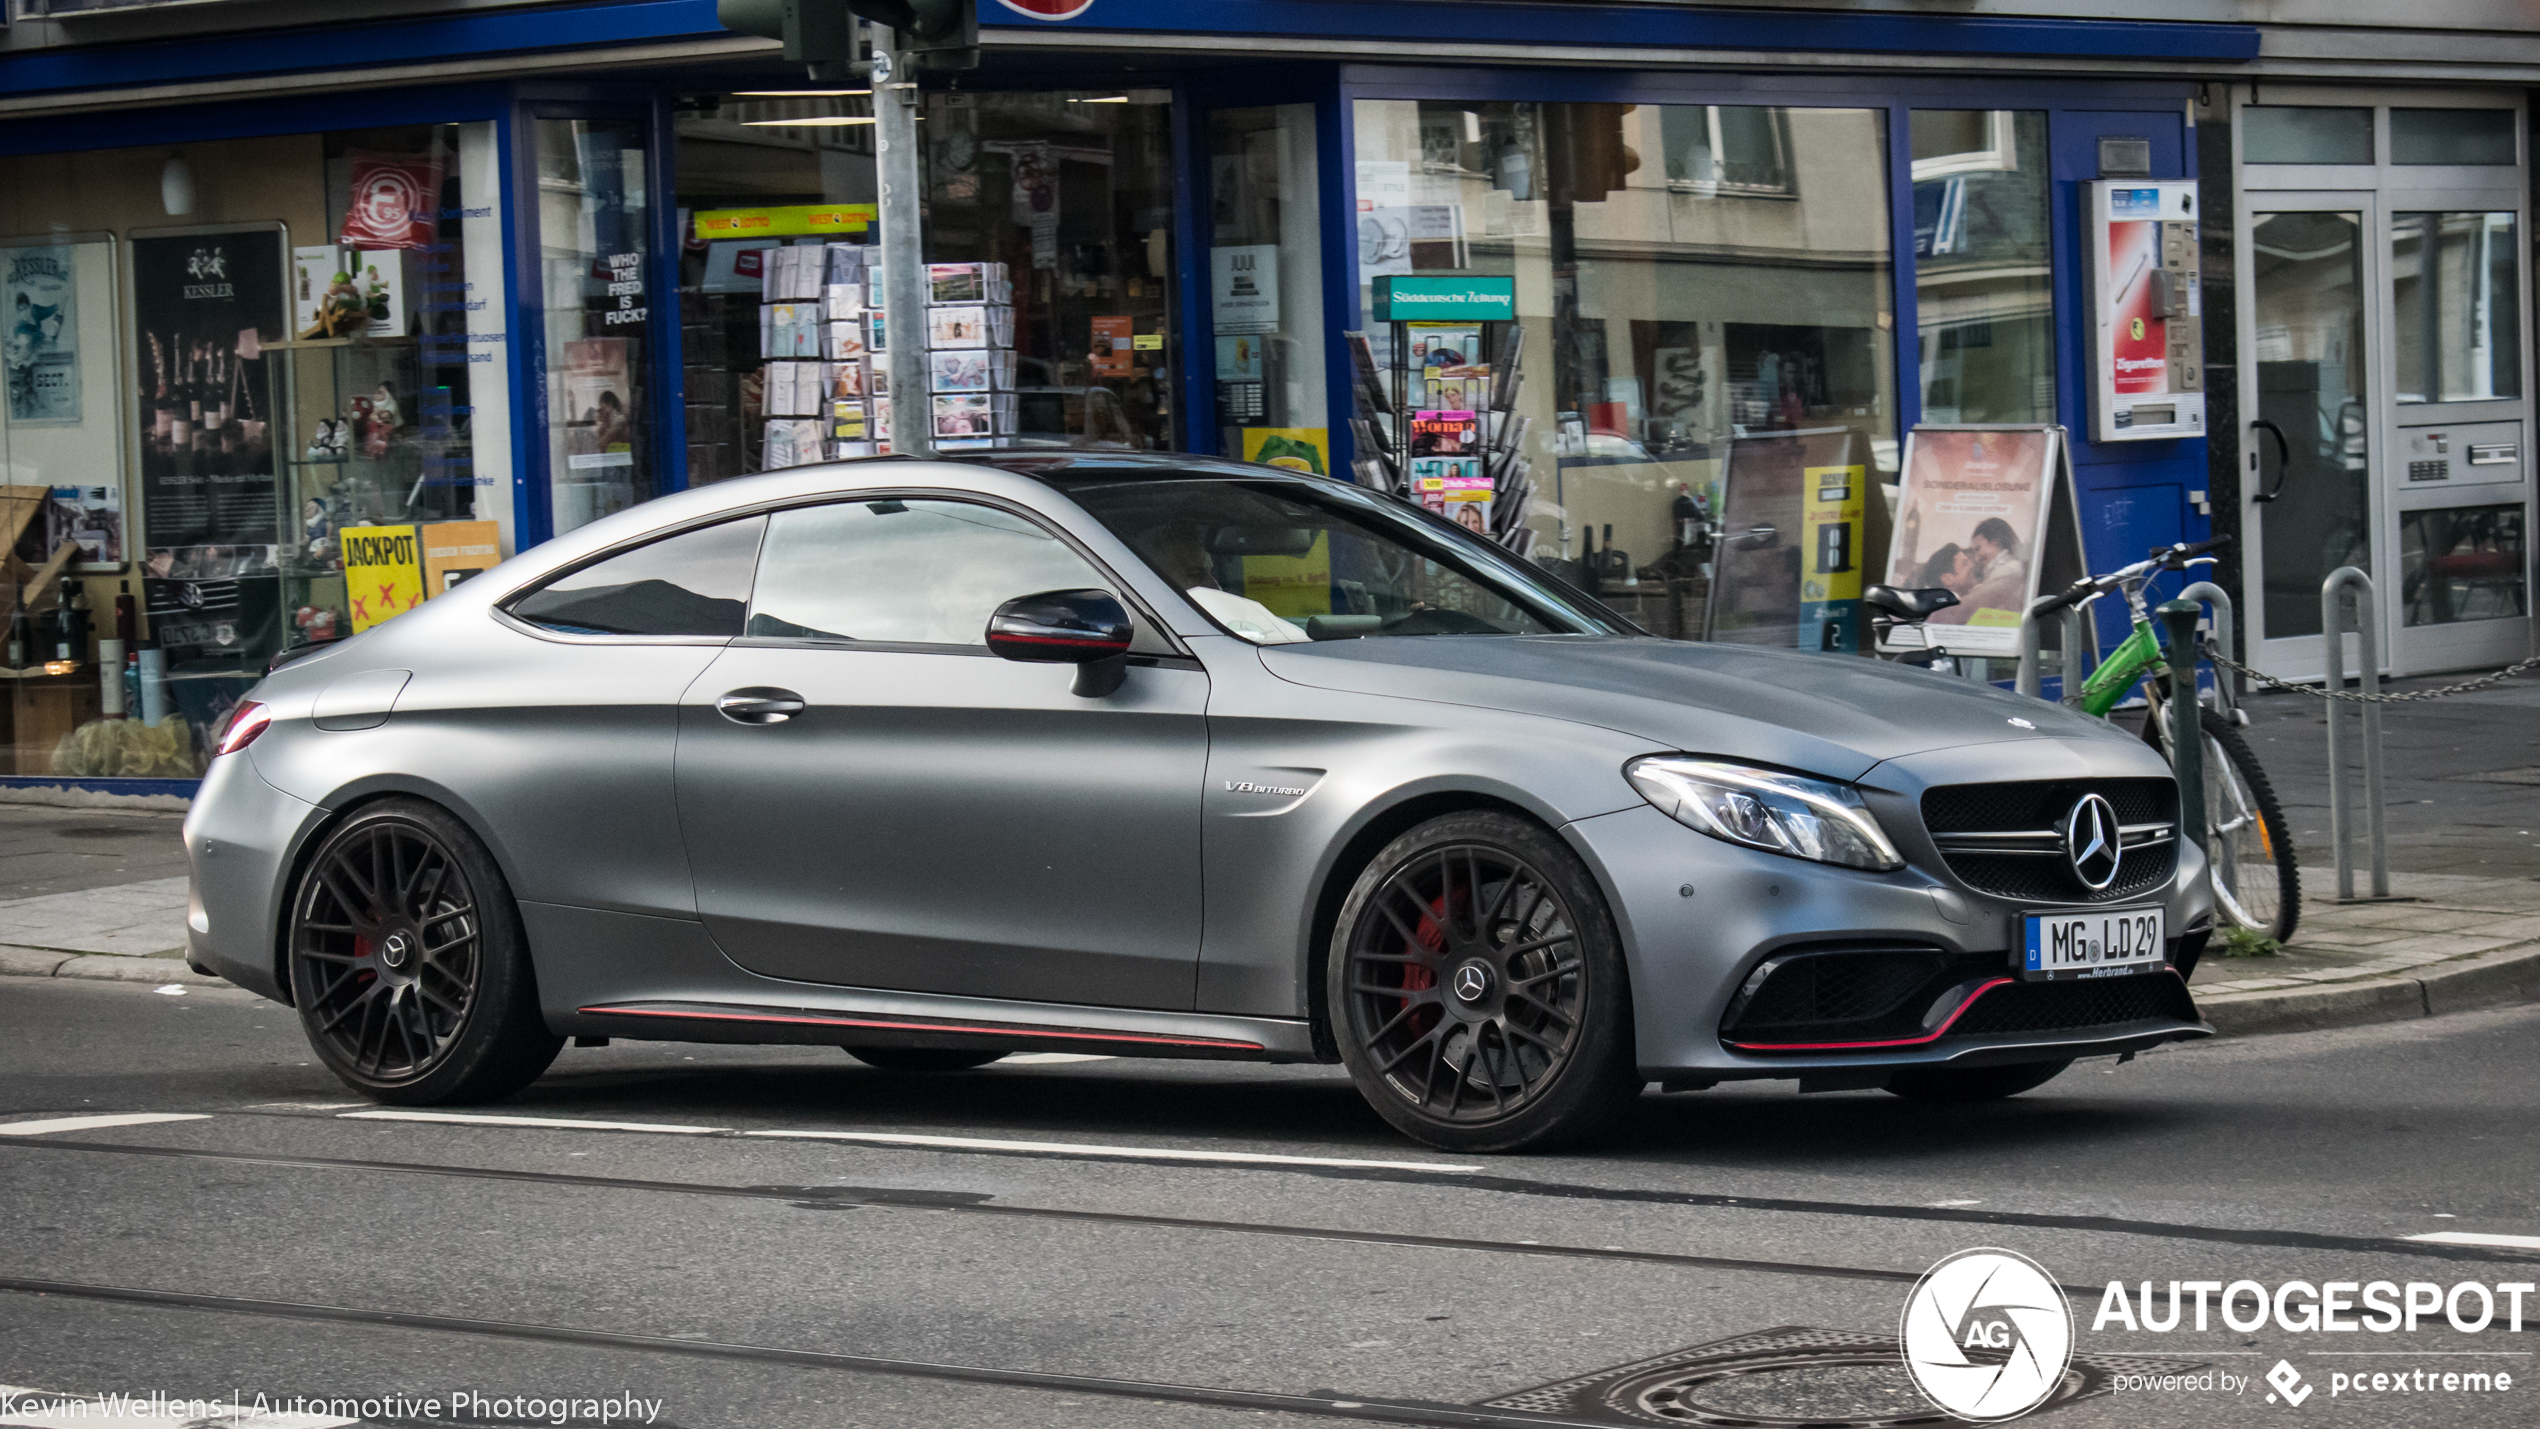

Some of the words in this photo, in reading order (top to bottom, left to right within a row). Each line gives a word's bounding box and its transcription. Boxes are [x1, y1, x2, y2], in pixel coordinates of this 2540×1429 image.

[383, 206, 401, 220] 95
[608, 252, 639, 268] WHO
[611, 267, 638, 281] THE
[184, 283, 234, 299] KESSLER
[608, 281, 642, 296] FRED
[619, 296, 632, 309] IS
[1393, 291, 1466, 303] Süddeutsche
[1466, 291, 1511, 306] Zeitung
[605, 308, 647, 325] FUCK?
[2116, 357, 2165, 373] Zigaretten
[1412, 421, 1476, 433] Woman
[346, 535, 414, 567] JACKPOT
[1225, 781, 1254, 792] V8
[1254, 786, 1305, 796] BITURBO
[2052, 921, 2087, 963] MG
[2104, 917, 2131, 960] LD
[2135, 915, 2157, 956] 29
[2030, 949, 2037, 961] D
[2077, 965, 2134, 979] www.Herbrand.de
